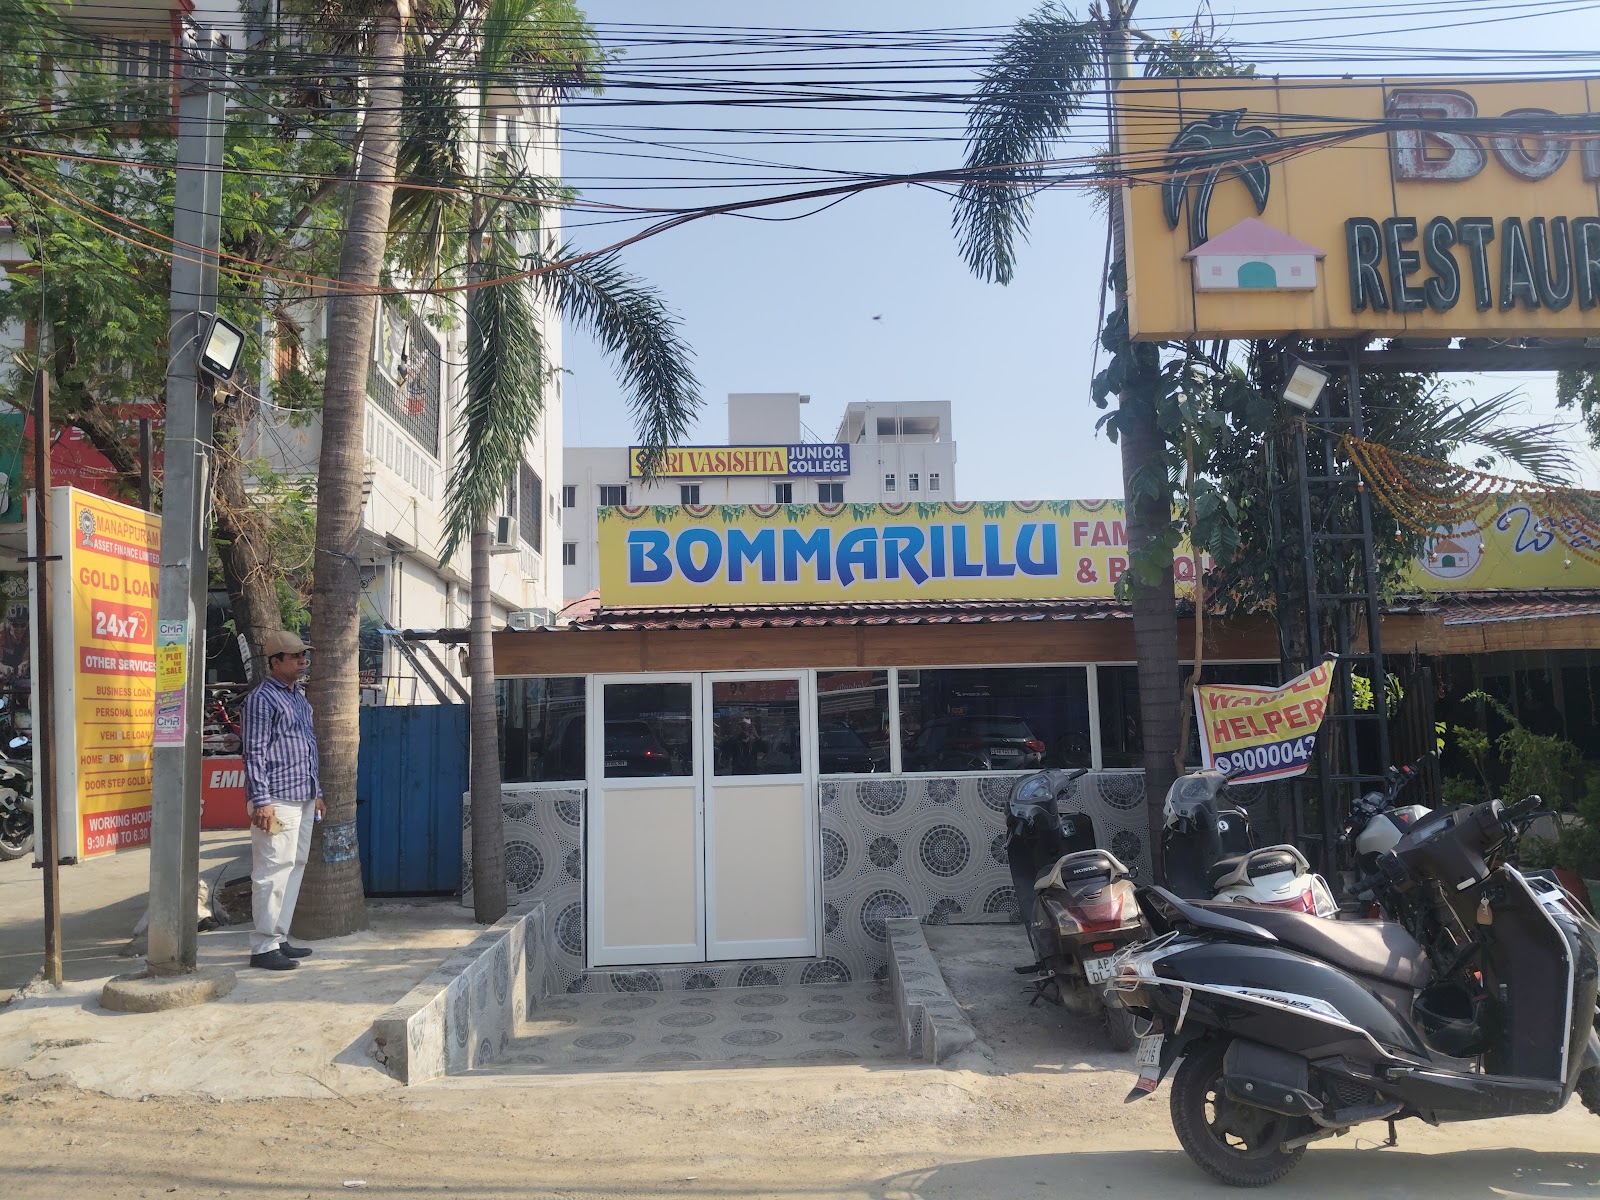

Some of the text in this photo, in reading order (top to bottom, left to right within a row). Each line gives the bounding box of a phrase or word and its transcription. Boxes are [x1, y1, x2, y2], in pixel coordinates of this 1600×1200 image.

[789, 446, 843, 460] JUNIOR
[687, 451, 785, 473] VASISHTA
[789, 460, 848, 473] COLLEGE
[96, 515, 159, 547] MANAPPURAM
[1074, 521, 1128, 547] FAM
[94, 538, 159, 564] ASSET FINANCE LIMITED
[628, 523, 1058, 588] BOMMARILLU
[1077, 557, 1098, 583] &
[80, 567, 159, 599] GOLD LOAN
[96, 611, 139, 639] 24x7
[160, 624, 184, 634] CMR
[85, 655, 156, 672] OTHER SERVICES
[165, 652, 182, 661] PLOT
[166, 666, 182, 675] SALE
[96, 685, 151, 698] BUSINESS LOAN
[95, 707, 153, 717] PERSONAL LOAN
[1212, 694, 1329, 744] HELPER
[156, 716, 180, 726] CMR
[132, 731, 150, 740] LOAN
[81, 754, 103, 765] HOME
[85, 779, 106, 791] DOOR
[107, 777, 126, 789] STEP
[127, 776, 146, 786] GOLD
[209, 770, 246, 789] EMI
[89, 814, 130, 832] WORKING
[87, 836, 105, 850] 9:30
[106, 833, 119, 848] AM
[120, 831, 132, 844] TO
[133, 828, 148, 841] 6.30
[1073, 865, 1099, 875] HONDA
